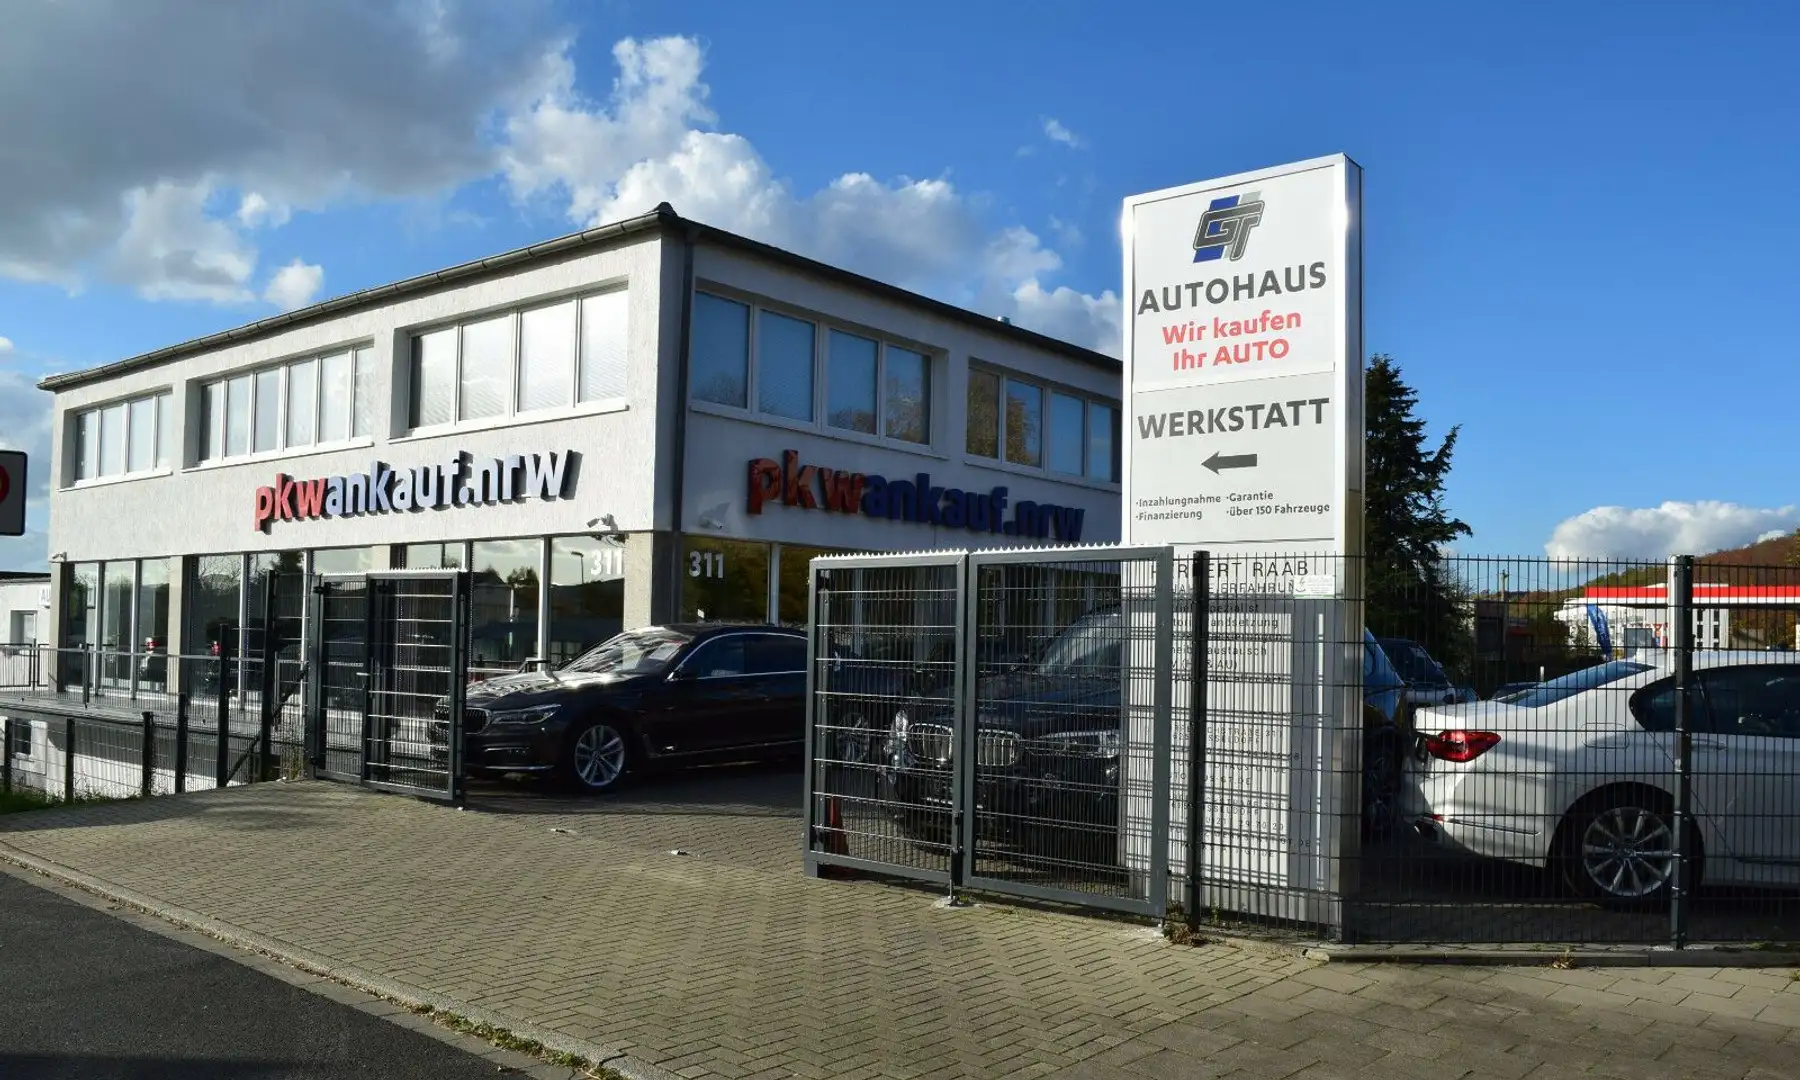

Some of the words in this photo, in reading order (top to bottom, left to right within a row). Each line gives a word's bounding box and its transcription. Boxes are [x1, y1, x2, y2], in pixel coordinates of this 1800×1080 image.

[1137, 261, 1326, 315] AUTOHAUS
[1162, 320, 1206, 345] Wir
[1213, 309, 1301, 339] kaufen
[1172, 349, 1207, 371] Ihr
[1213, 338, 1290, 366] AUTO
[1137, 397, 1330, 439] WERKSTATT
[255, 449, 582, 534] pkwankauf.nrw
[746, 448, 1085, 543] pkwankauf.nrw
[1229, 490, 1274, 502] Garantie
[1138, 509, 1203, 521] Finanzierung
[1230, 505, 1253, 516] über
[1256, 505, 1272, 515] 150
[1275, 503, 1330, 515] Fahrzeuge
[590, 551, 622, 576] 311
[688, 551, 725, 579] 311
[1253, 560, 1308, 577] RAAB
